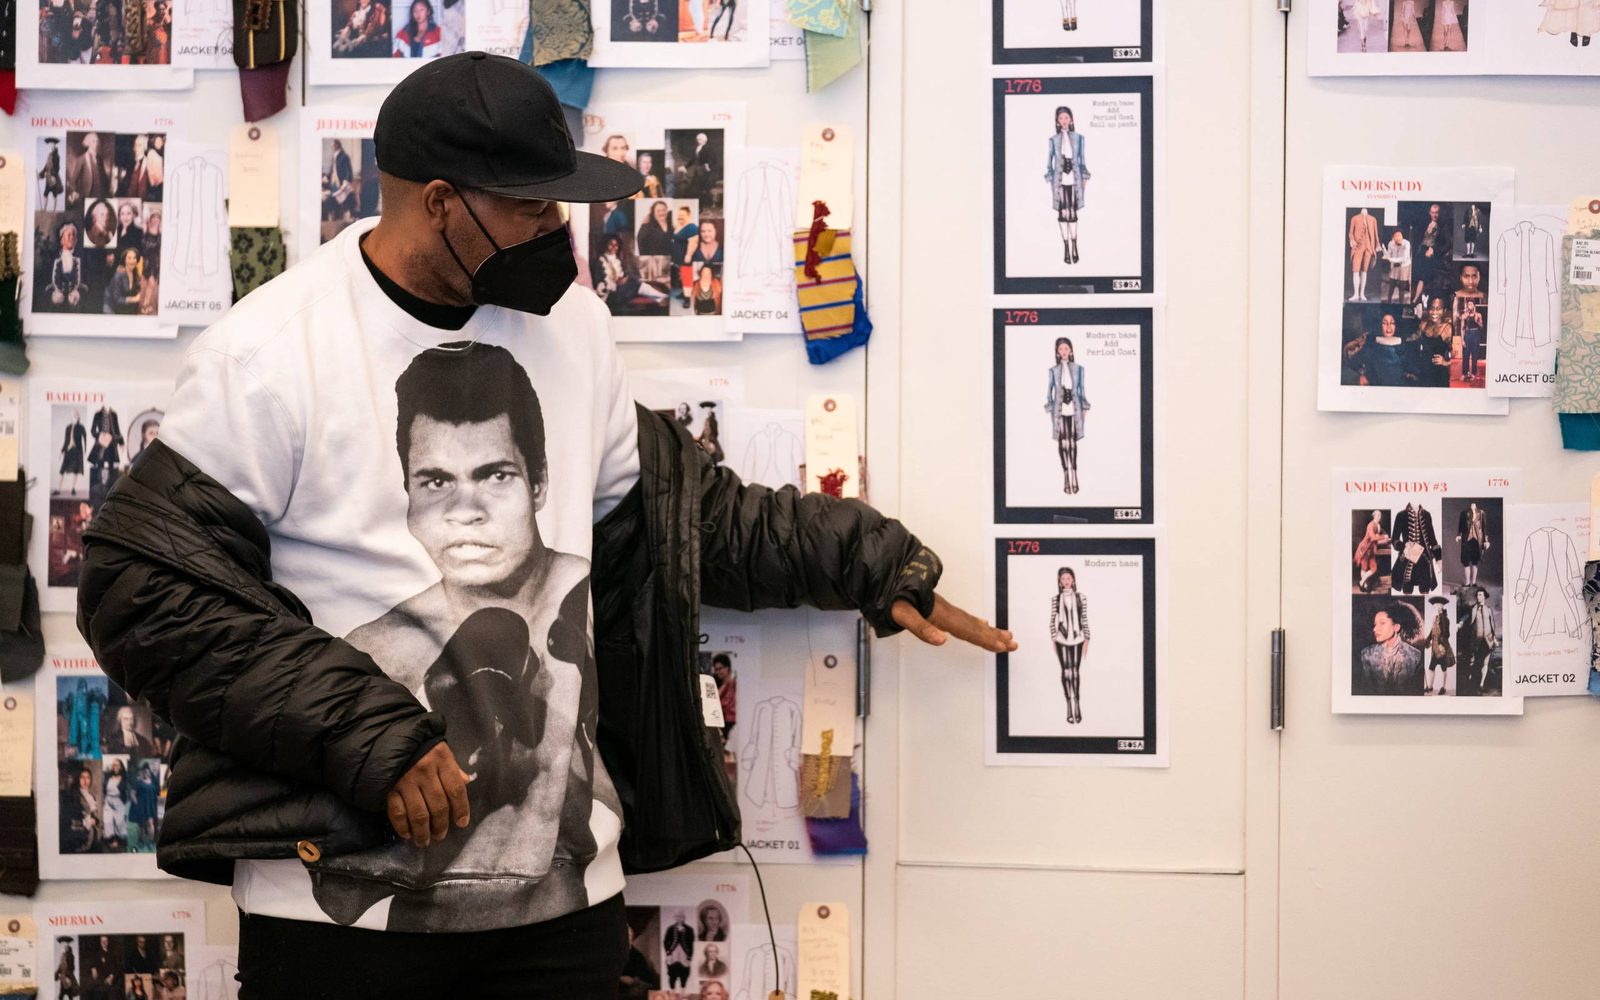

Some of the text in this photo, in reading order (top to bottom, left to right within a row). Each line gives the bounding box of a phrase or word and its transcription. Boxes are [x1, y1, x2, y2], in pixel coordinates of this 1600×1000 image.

[177, 45, 218, 55] JACKET
[1004, 79, 1042, 93] 1776
[31, 118, 94, 128] DICKINSON
[1341, 180, 1424, 192] UNDERSTUDY
[164, 301, 205, 310] JACKET
[730, 310, 788, 319] JACKET 04
[1005, 311, 1039, 324] 1776
[1495, 374, 1556, 383] JACKET 05
[1345, 482, 1448, 493] UNDERSTUDY #3
[1488, 478, 1509, 487] 1776
[1008, 541, 1040, 553] 1776
[1516, 674, 1576, 684] JACKET 02
[787, 840, 800, 850] 01
[48, 916, 104, 926] SHERMAN
